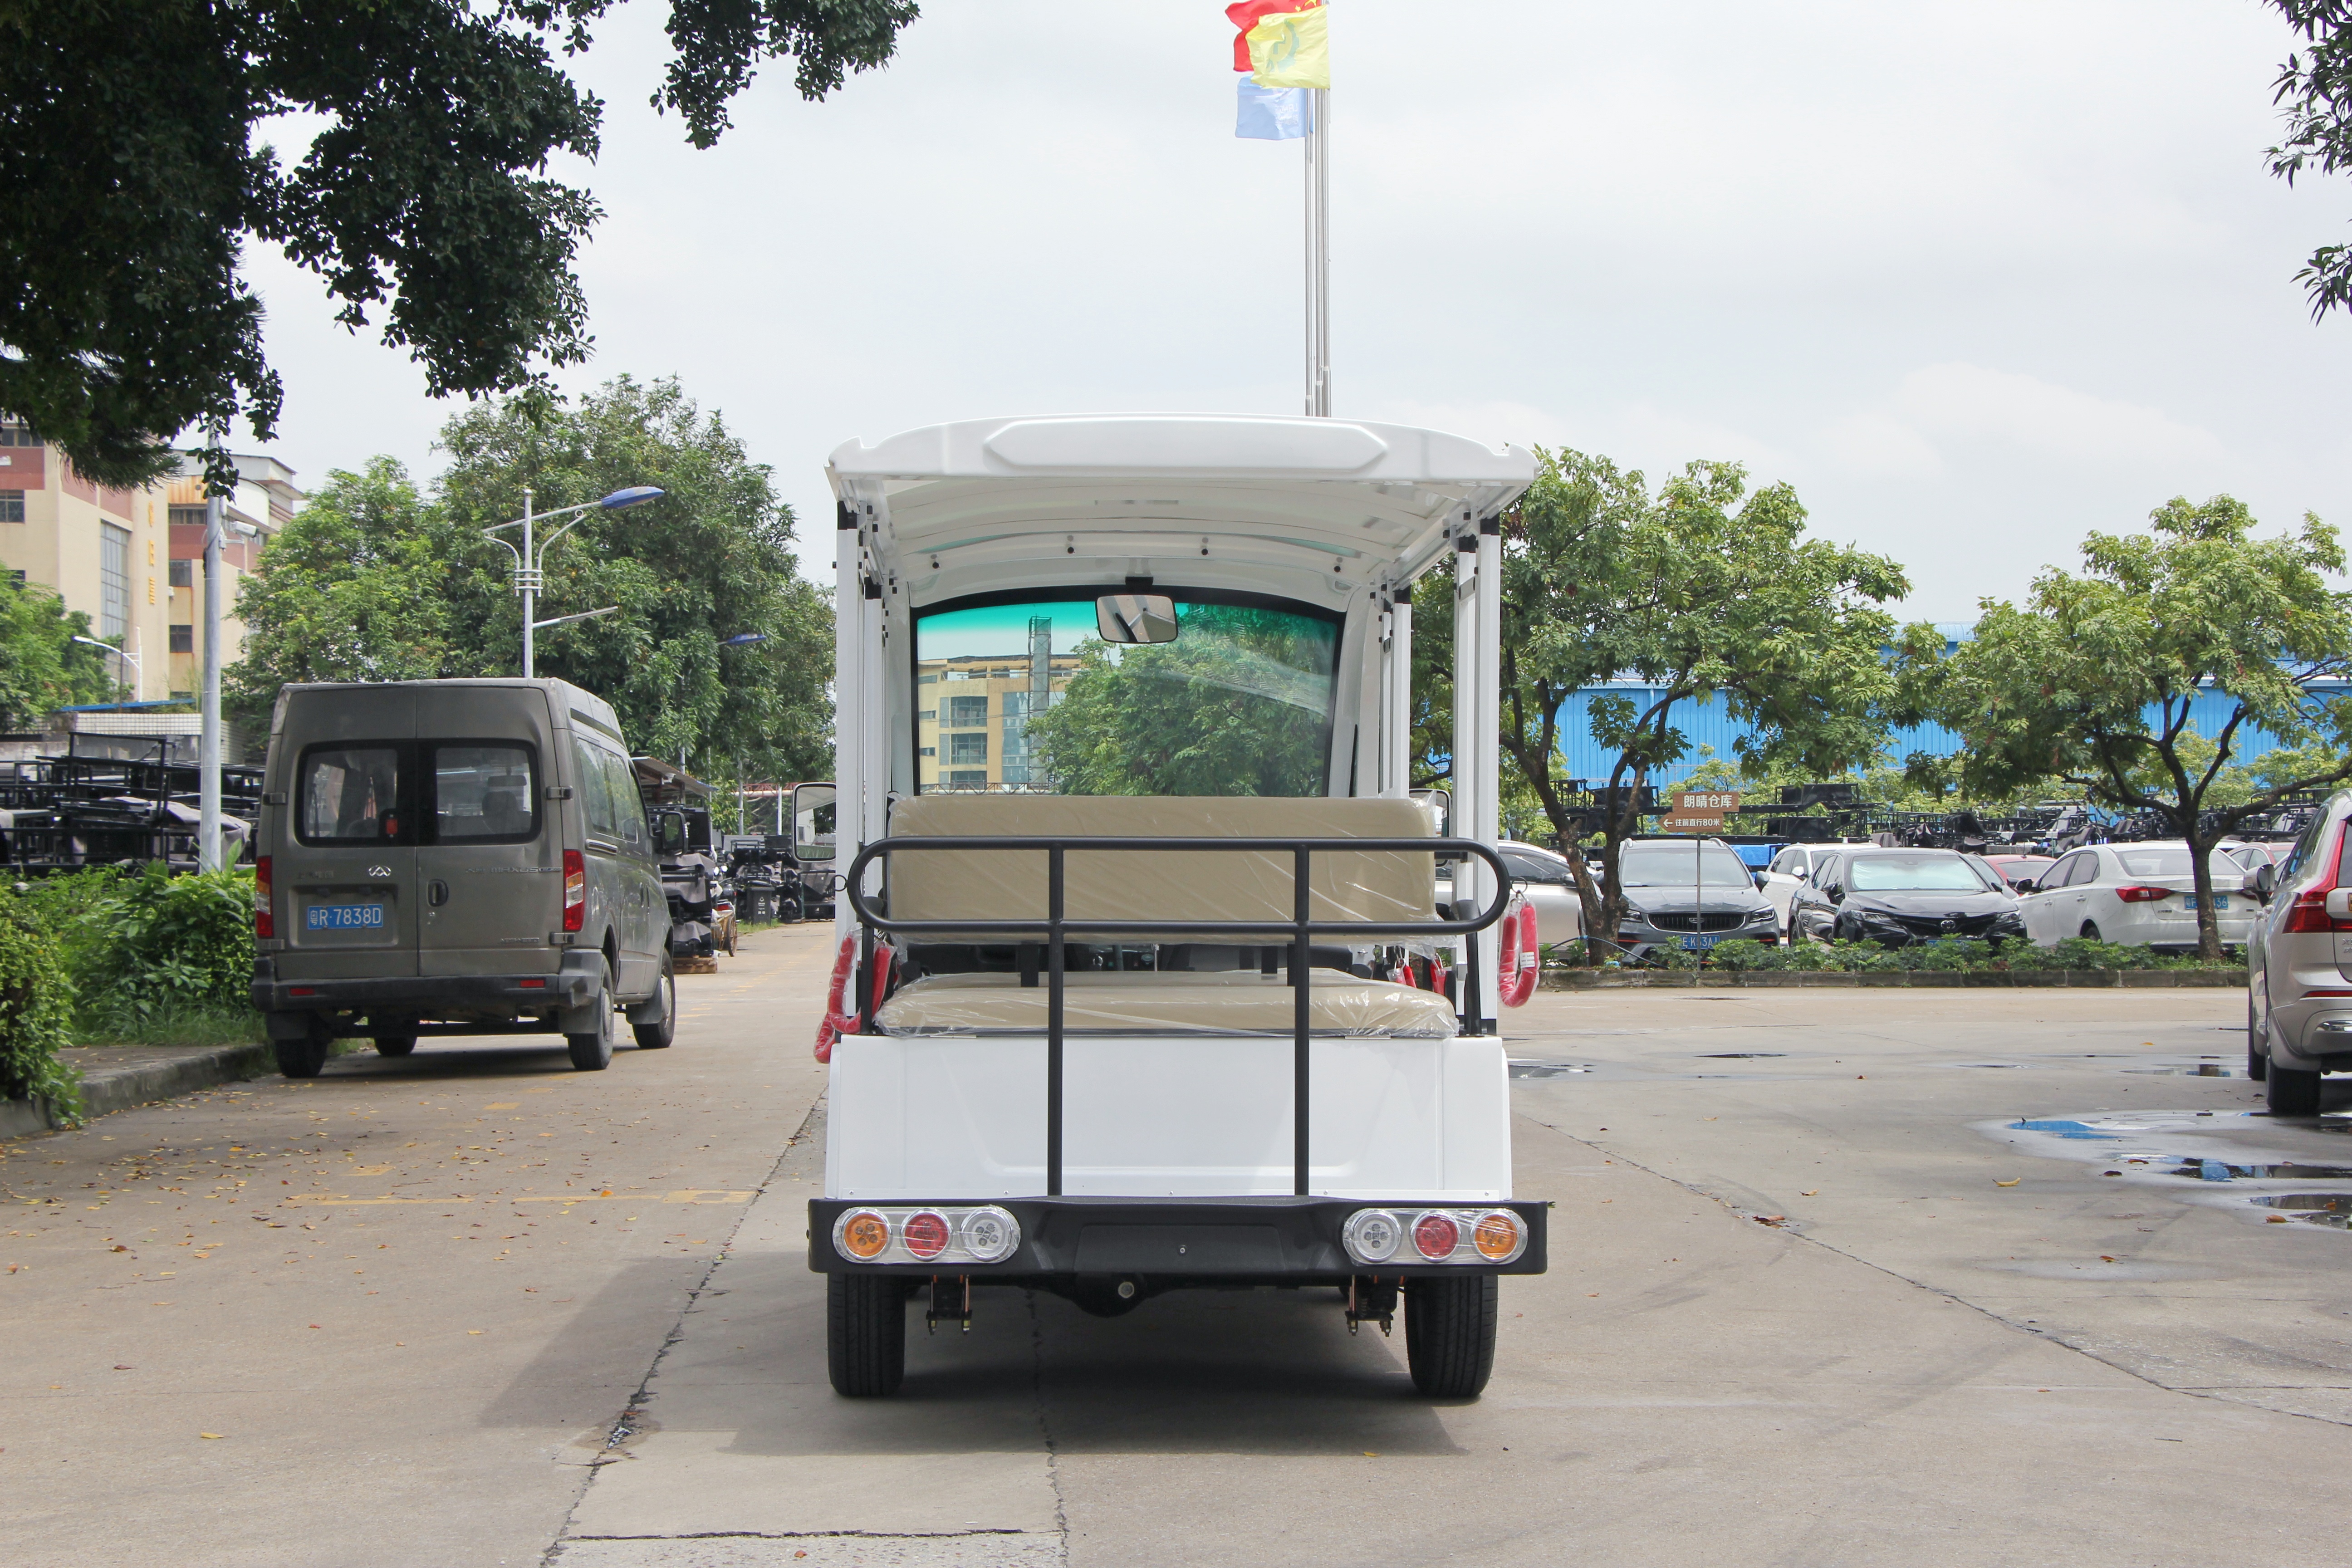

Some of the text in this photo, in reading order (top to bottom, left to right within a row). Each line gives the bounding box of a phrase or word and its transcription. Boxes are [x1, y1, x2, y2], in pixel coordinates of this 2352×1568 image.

[1684, 794, 1732, 808] 朗晴仓库
[1675, 818, 1720, 827] 往前直行80米
